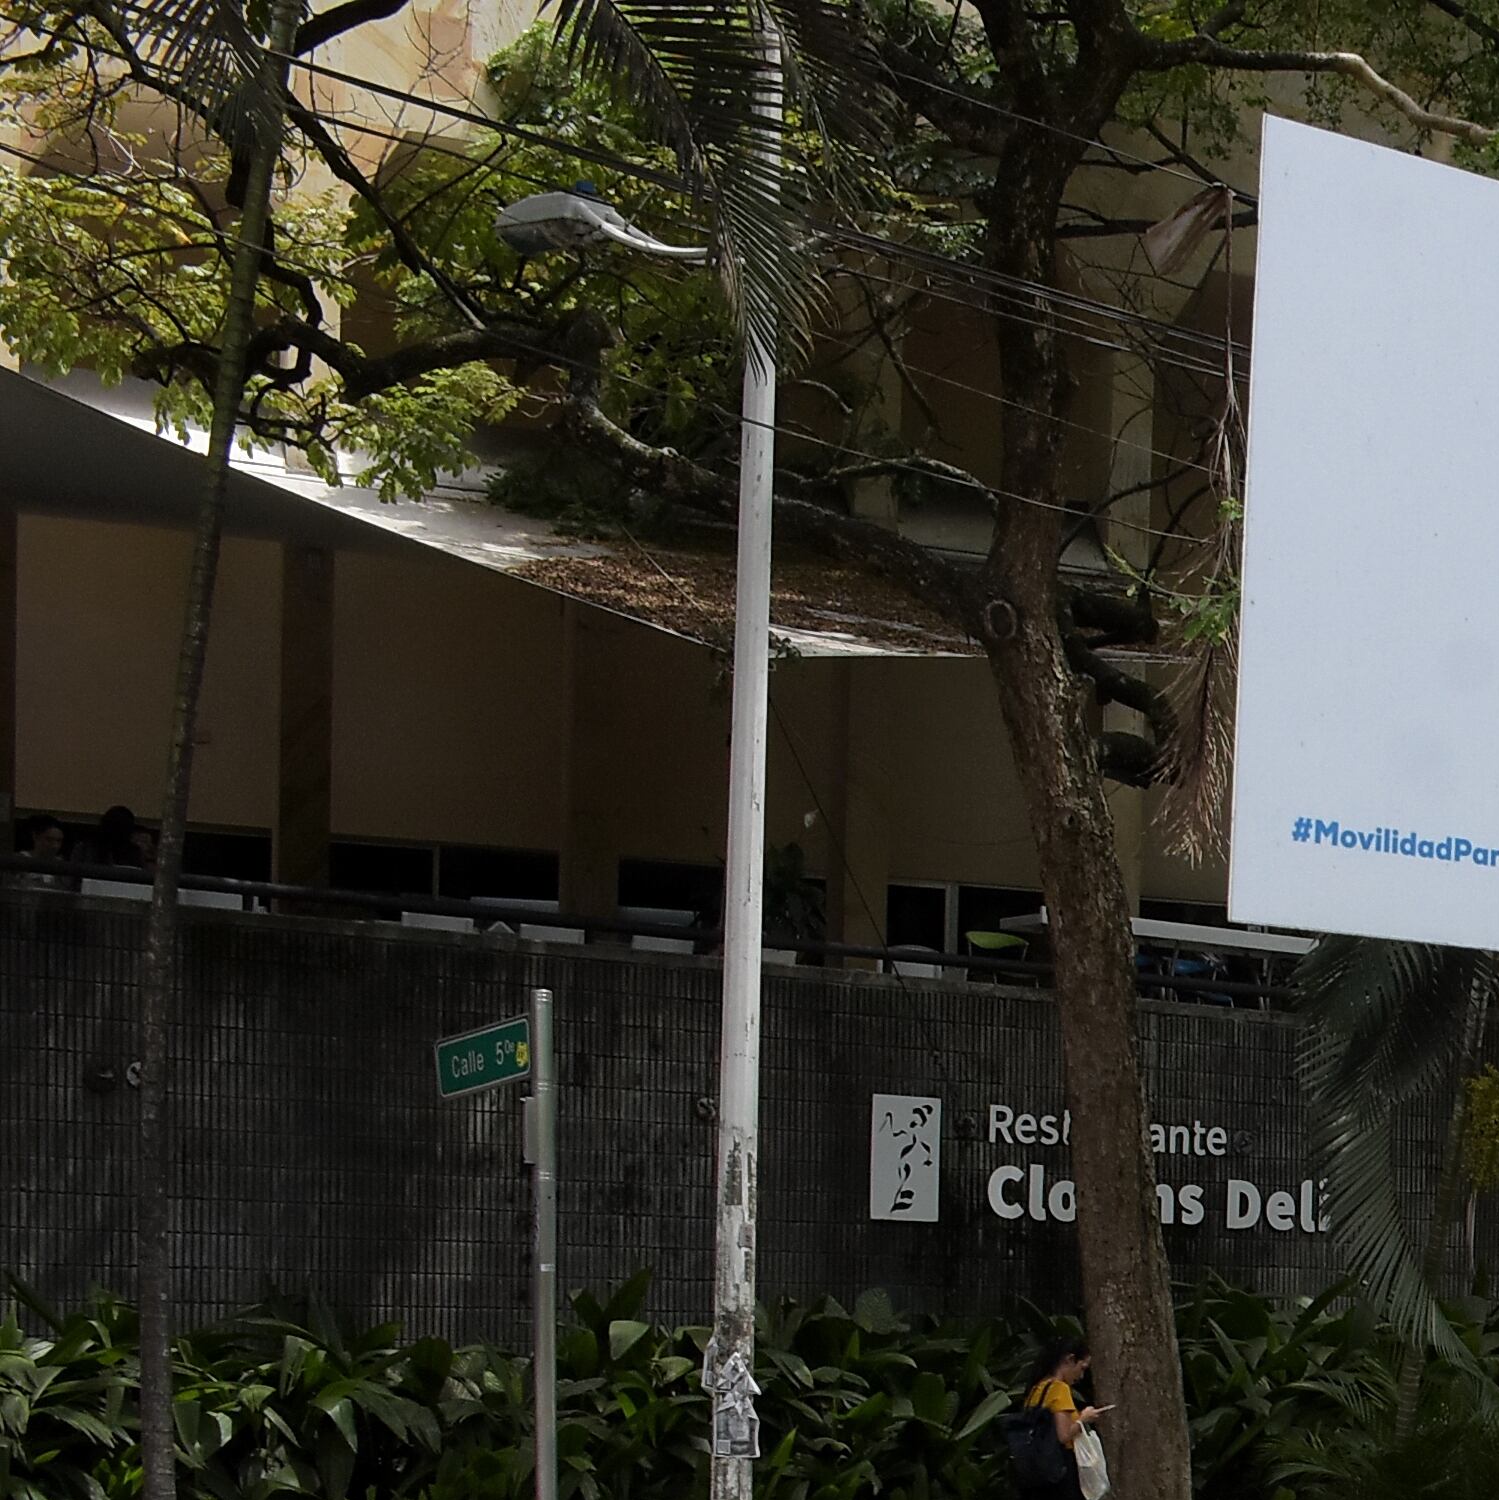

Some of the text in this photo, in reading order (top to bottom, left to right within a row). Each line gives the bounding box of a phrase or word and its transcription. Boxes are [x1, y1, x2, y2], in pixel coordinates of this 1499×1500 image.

[452, 1050, 485, 1078] Calle
[988, 1104, 1228, 1156] Restante
[987, 1163, 1205, 1226] Clons
